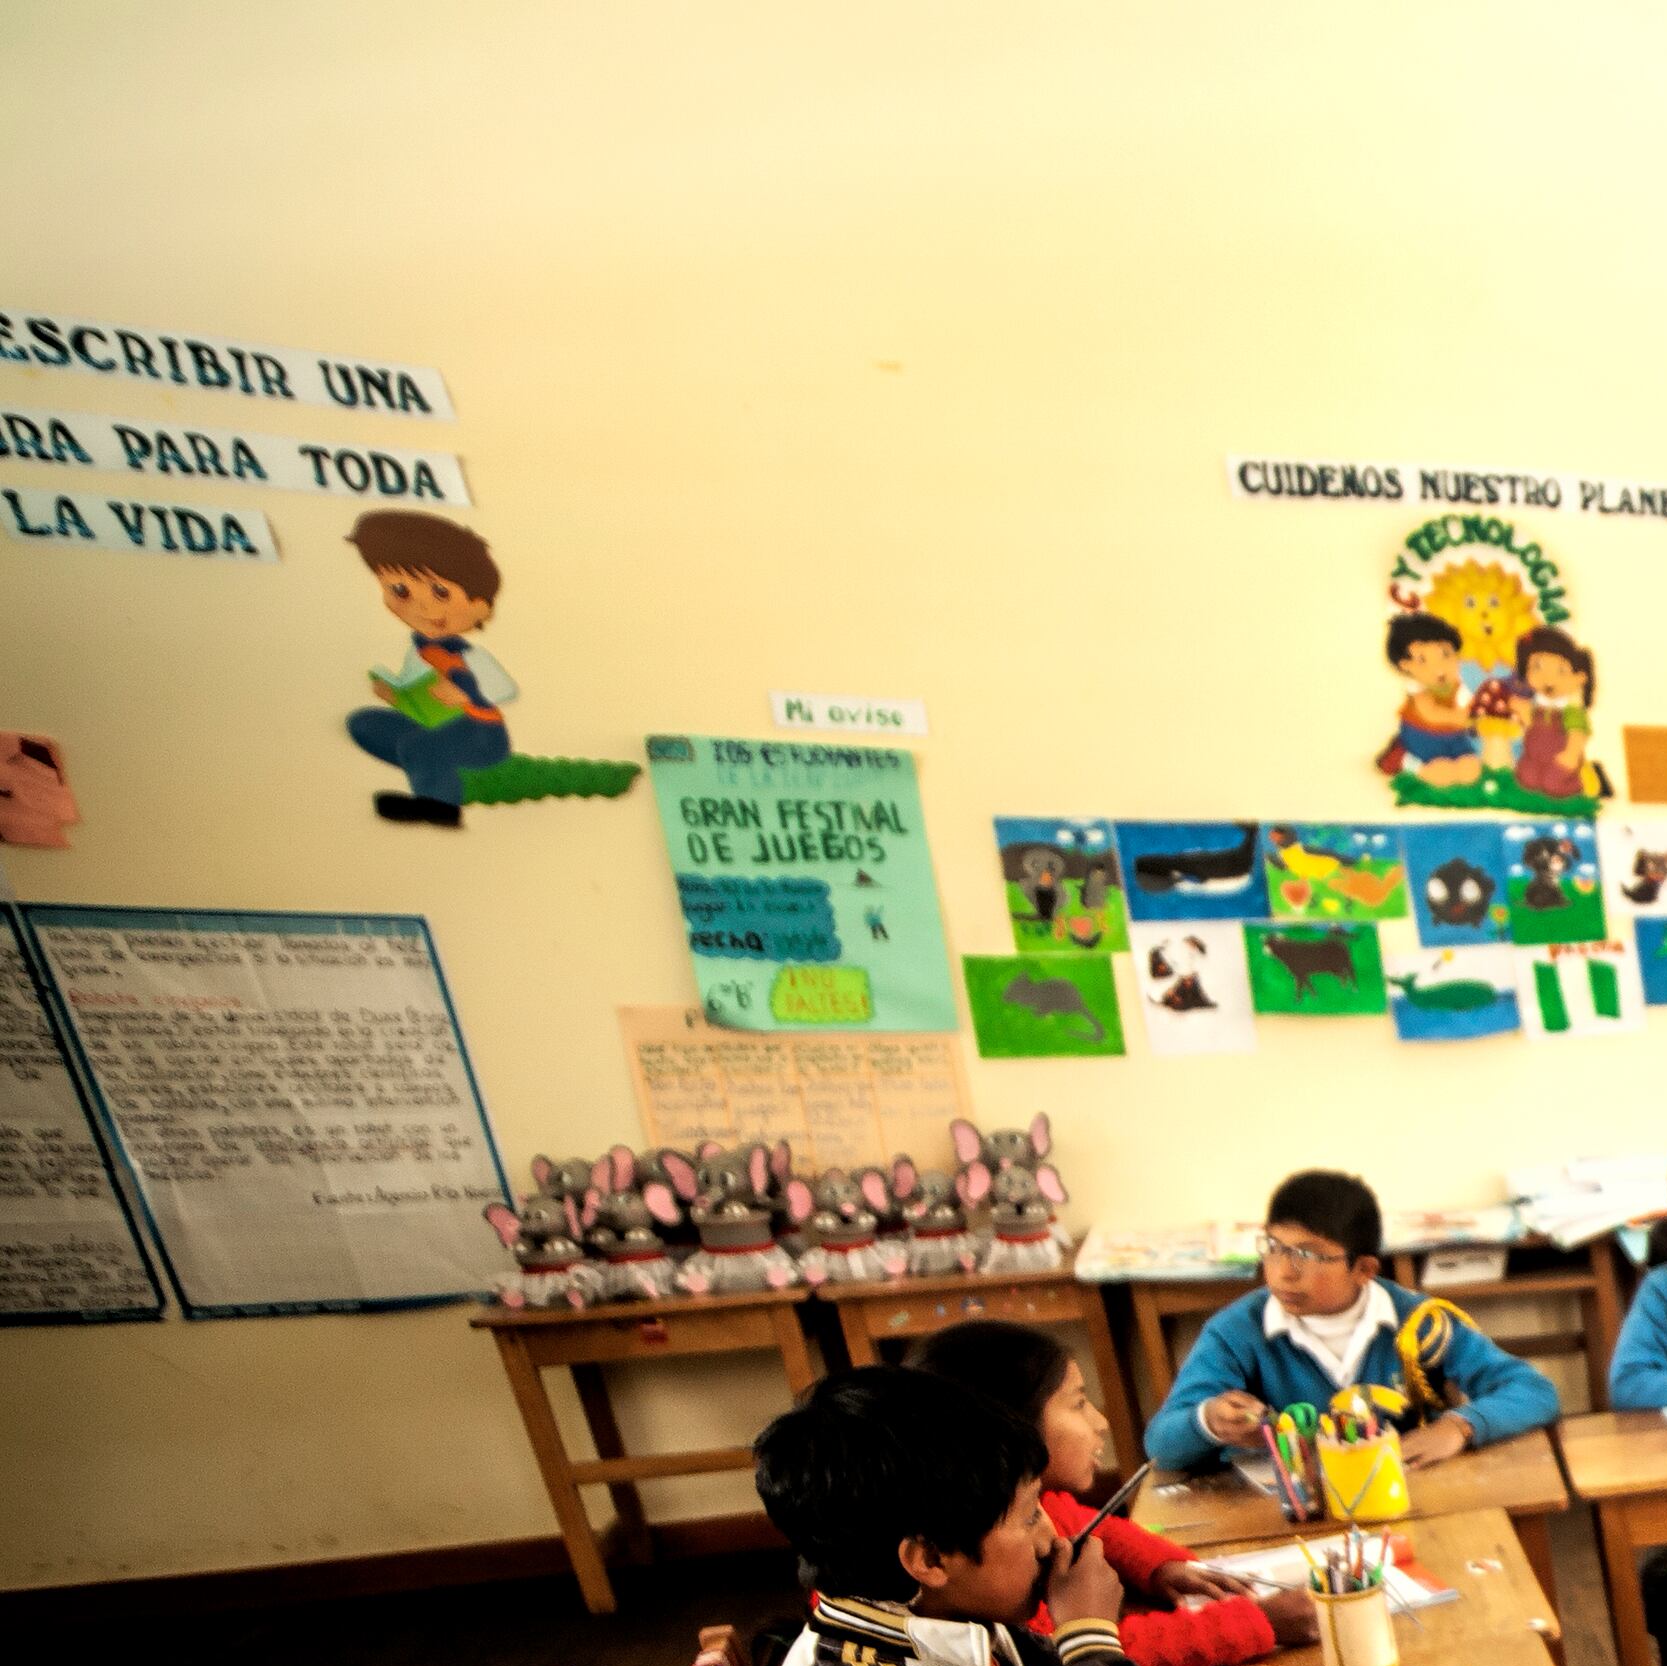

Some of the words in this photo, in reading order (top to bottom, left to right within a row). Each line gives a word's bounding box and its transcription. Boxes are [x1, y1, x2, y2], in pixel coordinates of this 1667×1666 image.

[317, 359, 433, 414] UNA
[0, 414, 93, 465] RA
[113, 424, 269, 481] PARA
[298, 444, 446, 500] TODA
[1420, 470, 1561, 507] NUESTRO
[3, 489, 96, 540] LA
[108, 500, 258, 556] VIDA
[785, 698, 815, 723] Mi
[680, 796, 763, 829] GRAN
[776, 798, 909, 835] FESTIVAL
[687, 832, 735, 865] DE
[751, 832, 887, 866] JUEGOS
